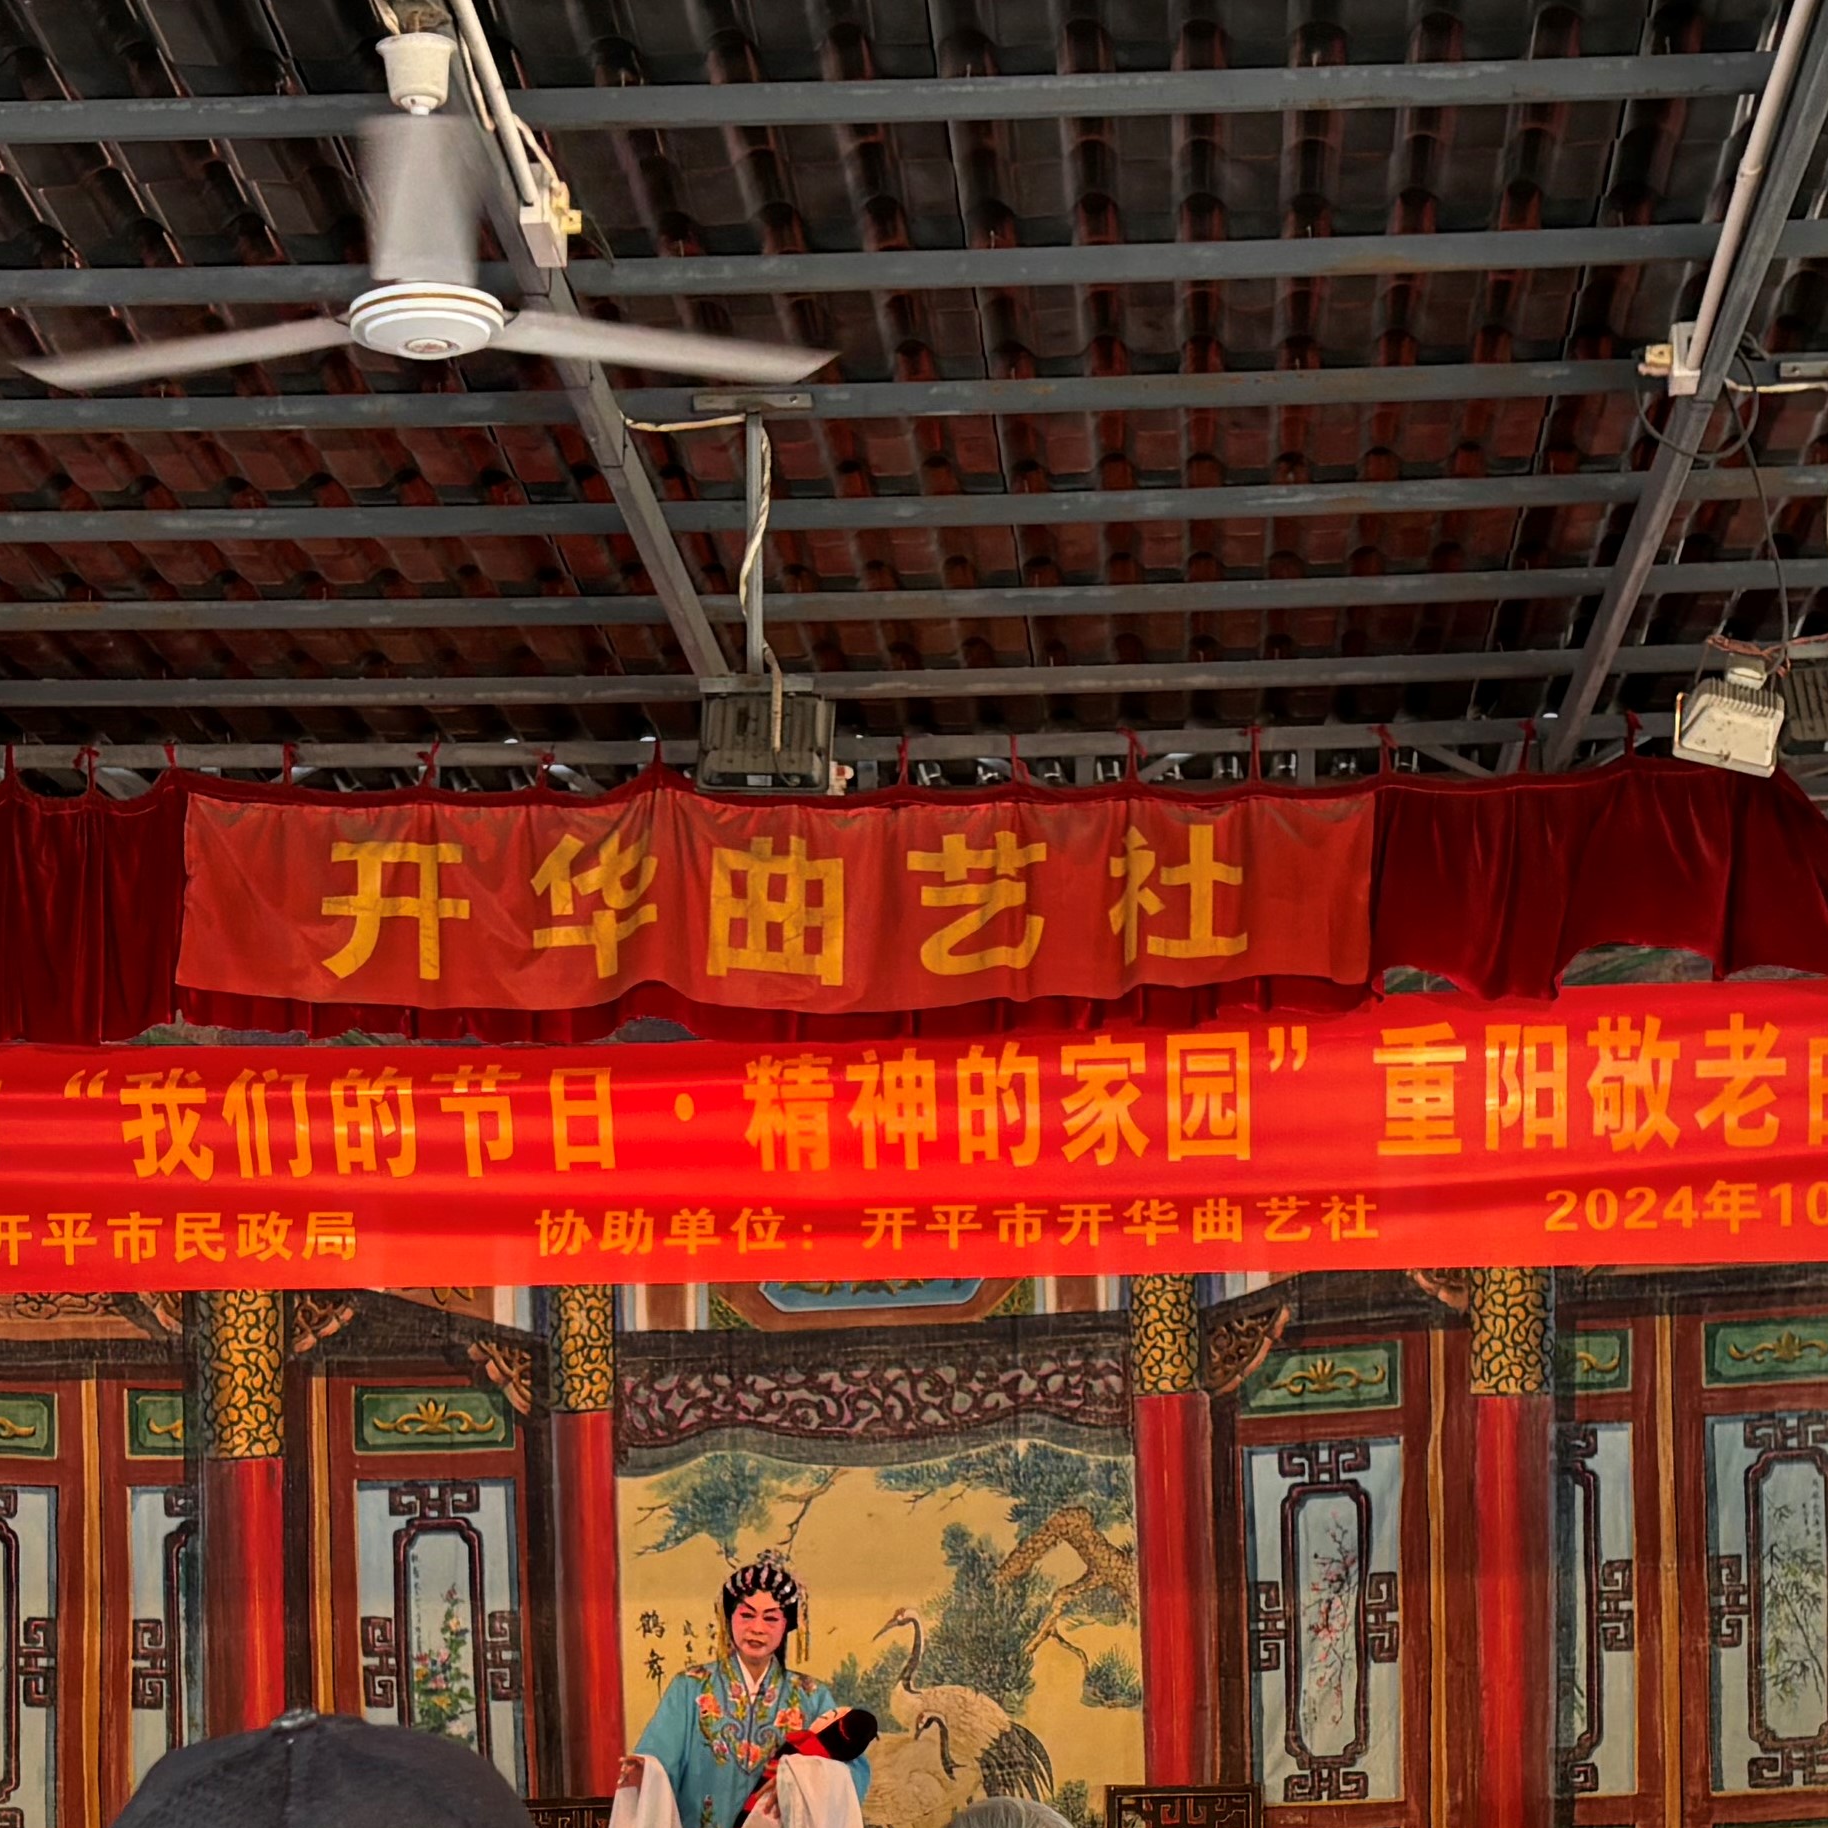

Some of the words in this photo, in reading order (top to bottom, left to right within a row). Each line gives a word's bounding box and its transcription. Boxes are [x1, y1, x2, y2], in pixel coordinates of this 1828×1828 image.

[321, 823, 1248, 986] 开华曲艺社
